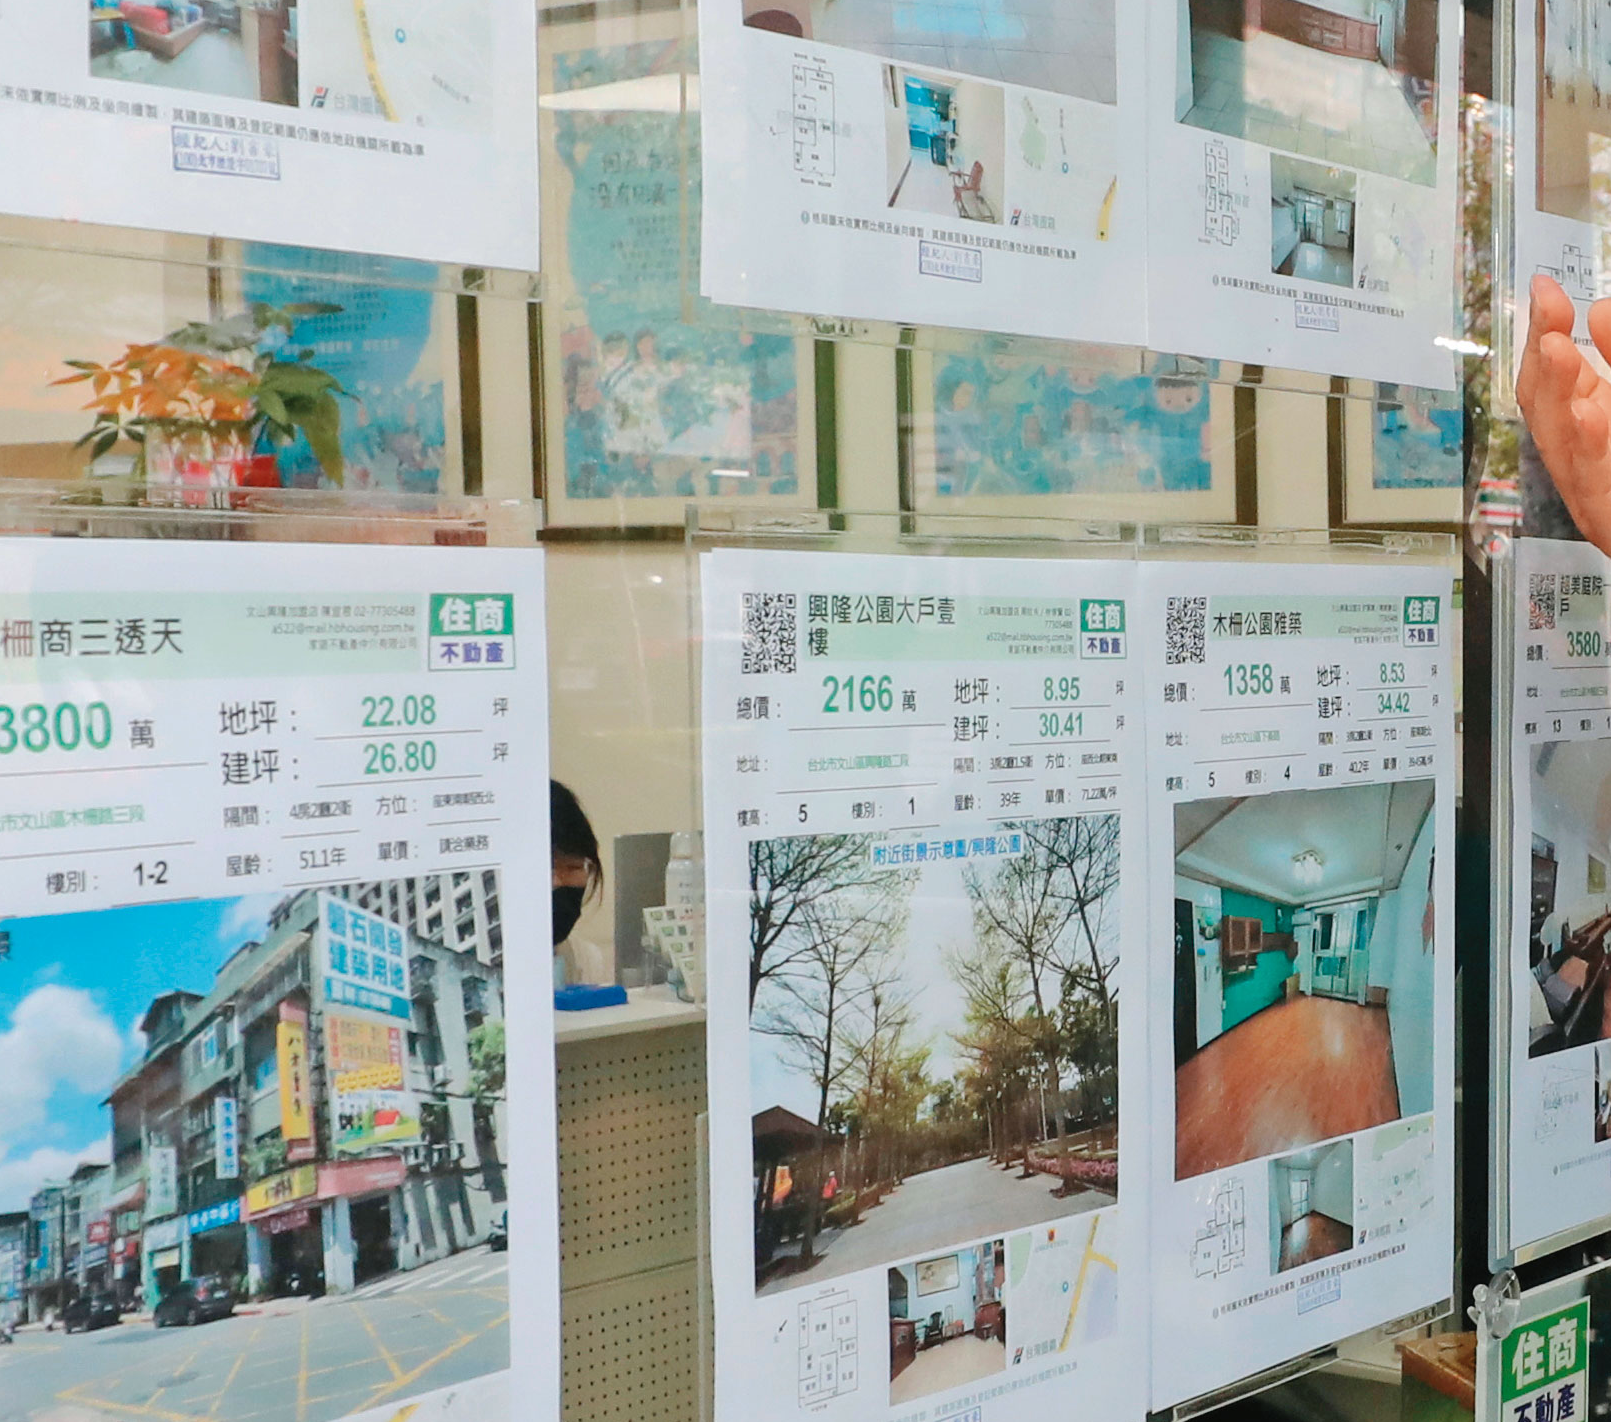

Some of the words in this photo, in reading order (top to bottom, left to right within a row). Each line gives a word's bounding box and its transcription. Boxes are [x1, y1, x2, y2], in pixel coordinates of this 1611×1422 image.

[439, 597, 505, 633] 住商
[808, 595, 956, 626] 興隆公園大戶壹
[1085, 602, 1122, 631] 住商
[1213, 612, 1302, 637] 木柵公園雅築
[1406, 599, 1437, 622] 住商
[439, 641, 505, 665] 不動產
[808, 627, 829, 657] 樓
[1086, 637, 1121, 654] 不動產
[1566, 630, 1600, 658] 3580
[1224, 663, 1273, 696] 1358
[1380, 663, 1405, 683] 8.53
[822, 674, 893, 713] 2166
[902, 689, 917, 713] 萬
[1043, 677, 1080, 701] 8.95
[361, 694, 437, 729] 22.08
[492, 697, 509, 718] 坪
[1378, 693, 1410, 714] 34.42
[129, 718, 155, 749] 萬
[1039, 713, 1084, 738] 30.41
[363, 740, 437, 776] 26.80
[492, 742, 509, 763] 坪
[798, 805, 808, 822] 5
[133, 860, 169, 887] 1-2
[1512, 1318, 1577, 1390] 住商
